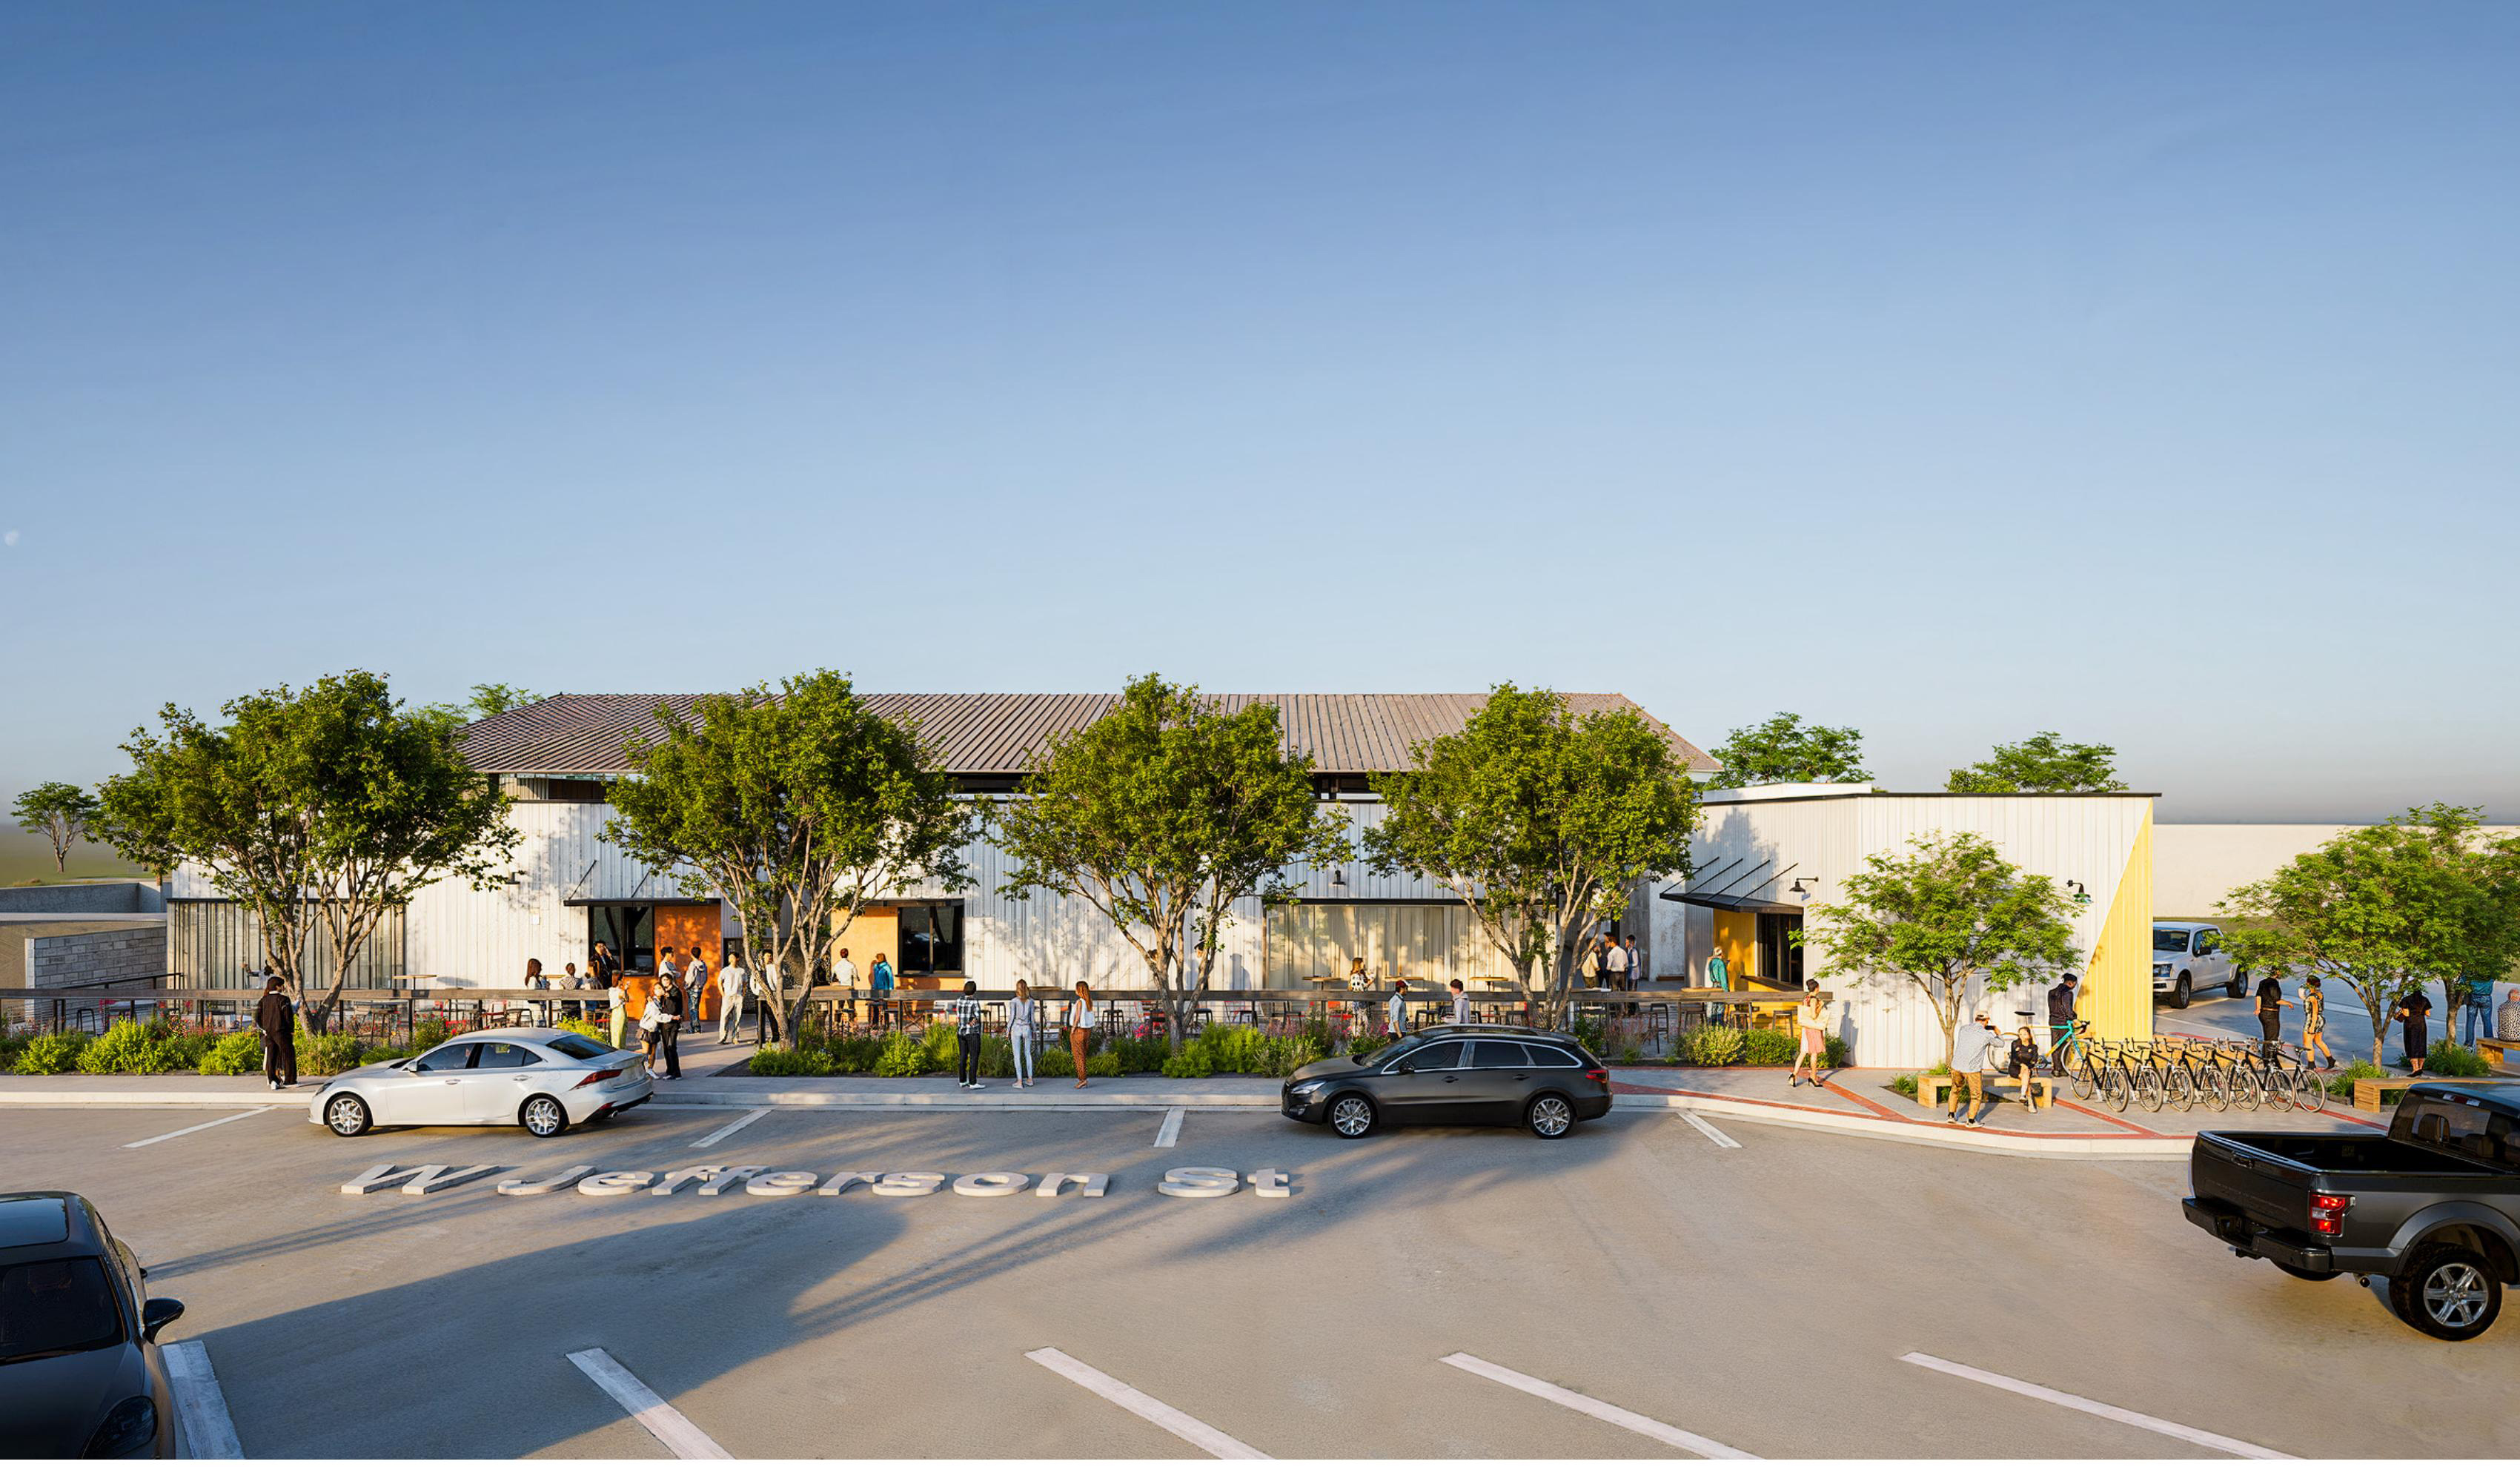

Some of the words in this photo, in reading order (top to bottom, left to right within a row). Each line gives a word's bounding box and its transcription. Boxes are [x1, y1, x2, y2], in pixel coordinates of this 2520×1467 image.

[341, 1164, 500, 1194] W
[498, 1165, 1110, 1197] Jefferson
[1158, 1167, 1290, 1198] St
